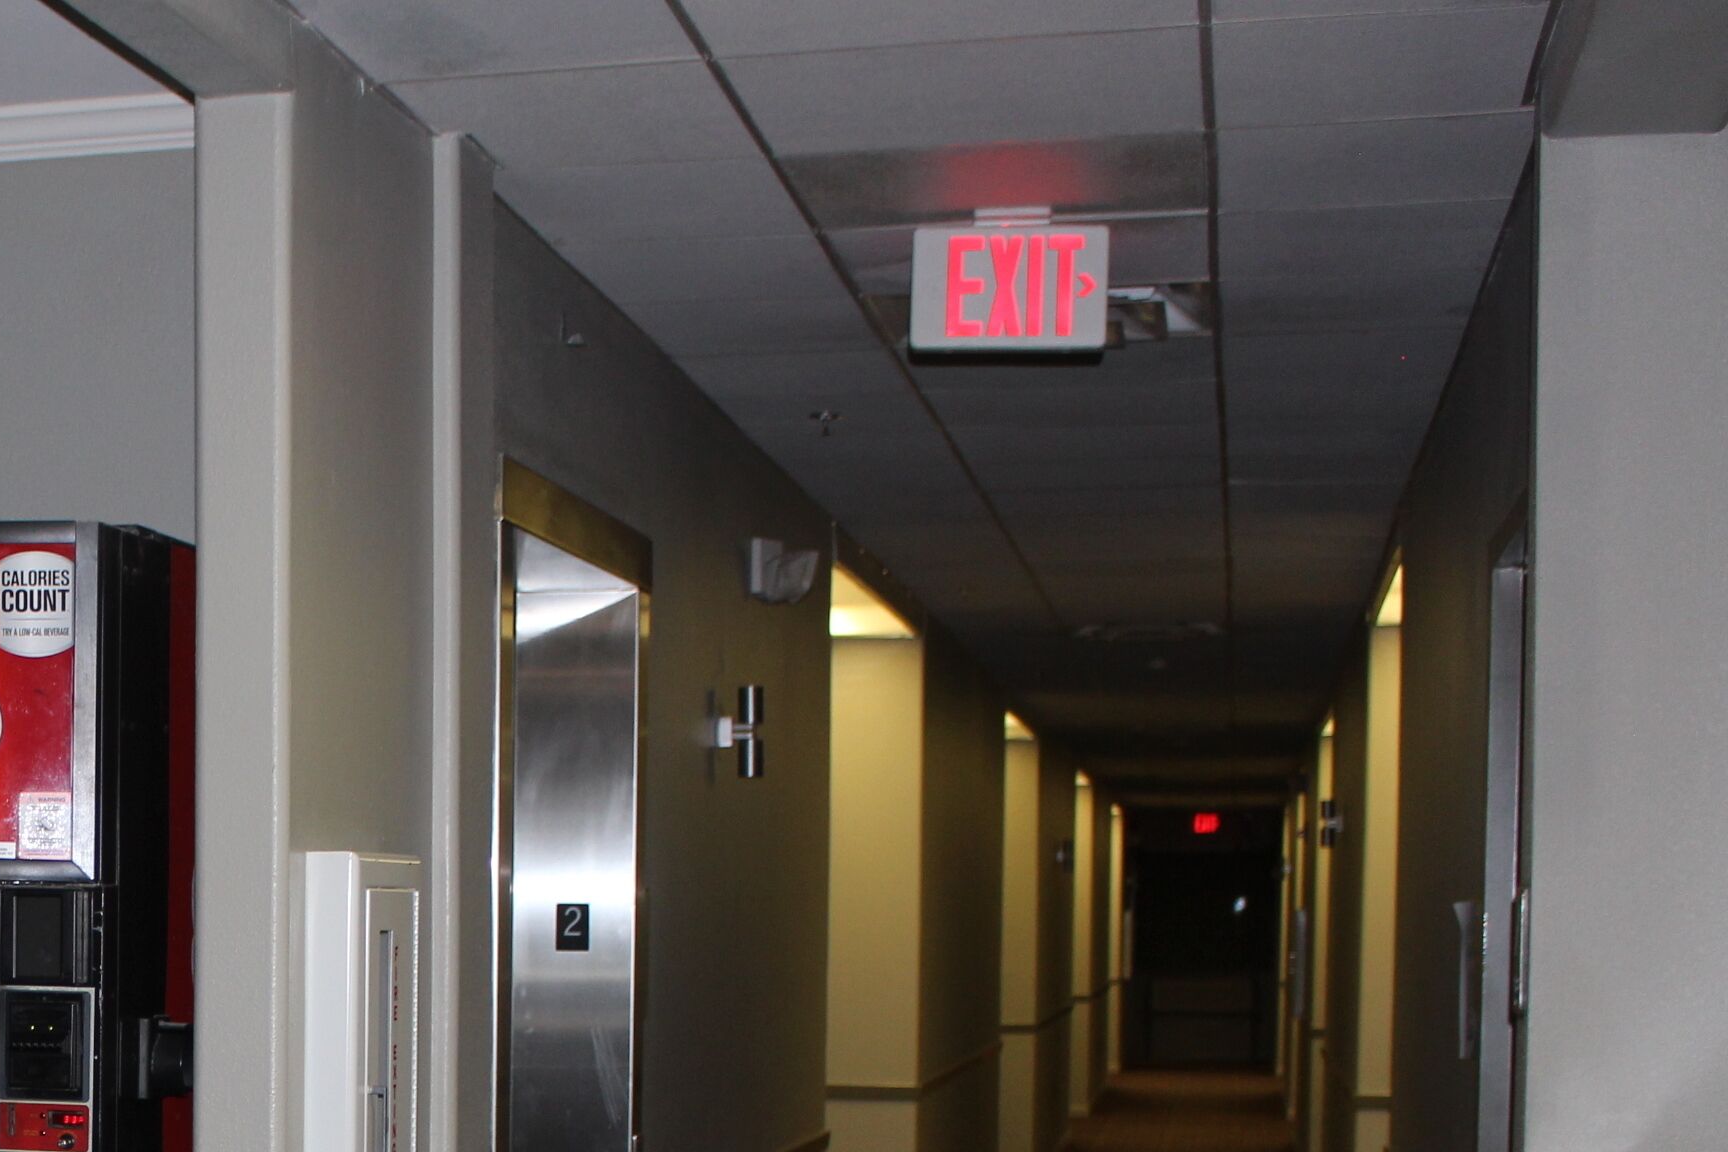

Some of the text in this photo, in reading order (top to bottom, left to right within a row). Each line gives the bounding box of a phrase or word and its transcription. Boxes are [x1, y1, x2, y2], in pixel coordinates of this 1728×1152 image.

[944, 234, 1086, 338] EXIT
[1, 570, 70, 587] CALORIES
[1, 589, 70, 613] COUNT
[563, 906, 582, 937] 2
